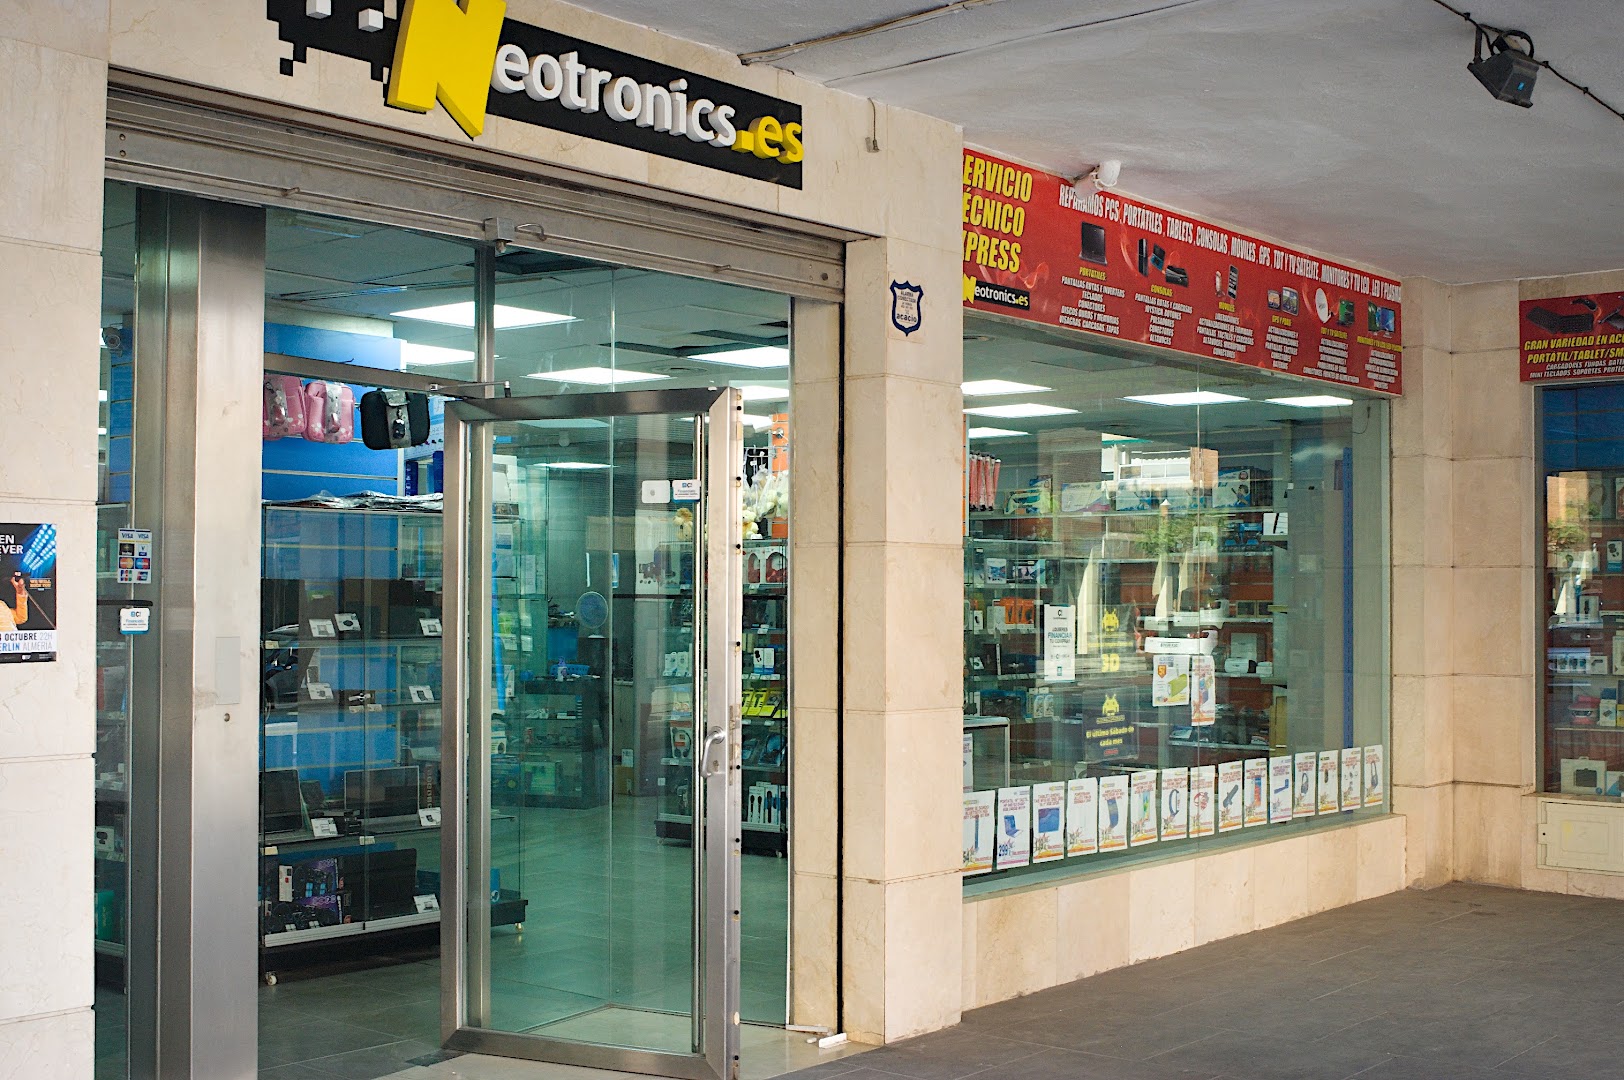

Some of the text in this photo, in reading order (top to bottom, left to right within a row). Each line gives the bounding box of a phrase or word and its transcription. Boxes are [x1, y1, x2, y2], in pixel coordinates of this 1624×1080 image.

[388, 0, 804, 165] Neotronics.es
[963, 154, 1033, 203] ERVICIO
[963, 187, 1026, 238] ÉCNICO
[963, 230, 1022, 274] PRESS
[1524, 340, 1549, 351] GRAN
[1550, 336, 1595, 349] VARIEDAD
[1596, 334, 1608, 345] EN
[0, 544, 24, 554] VER
[5, 632, 38, 641] OCTUBRE
[40, 631, 53, 641] 22H
